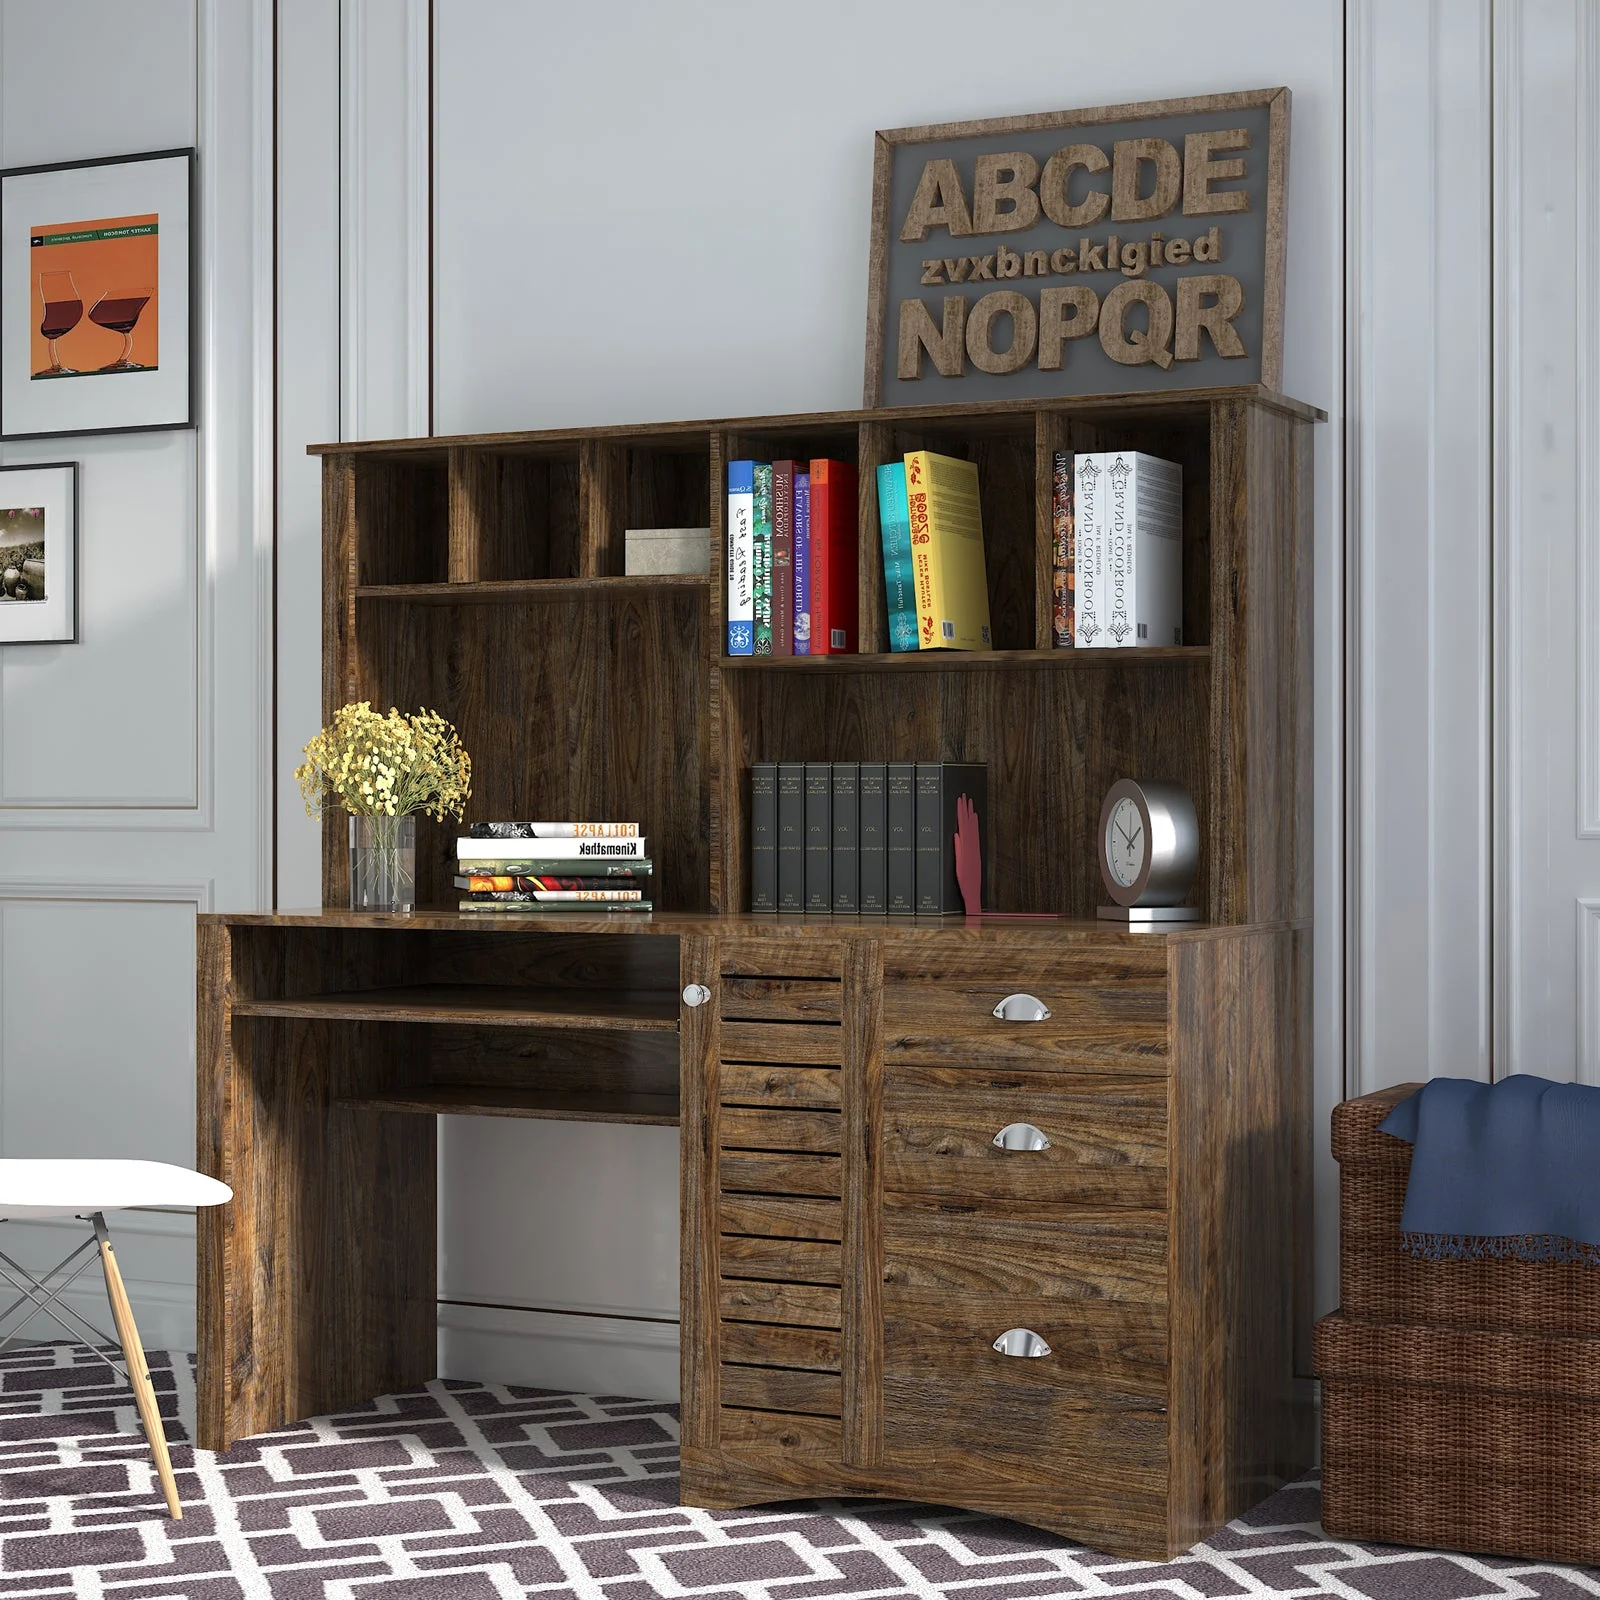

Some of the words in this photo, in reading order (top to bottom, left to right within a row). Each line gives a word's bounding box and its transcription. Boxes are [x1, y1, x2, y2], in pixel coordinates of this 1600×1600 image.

[899, 128, 1251, 242] ABCDE
[920, 226, 1223, 285] zvxbncklgied
[897, 274, 1249, 381] NOPQR
